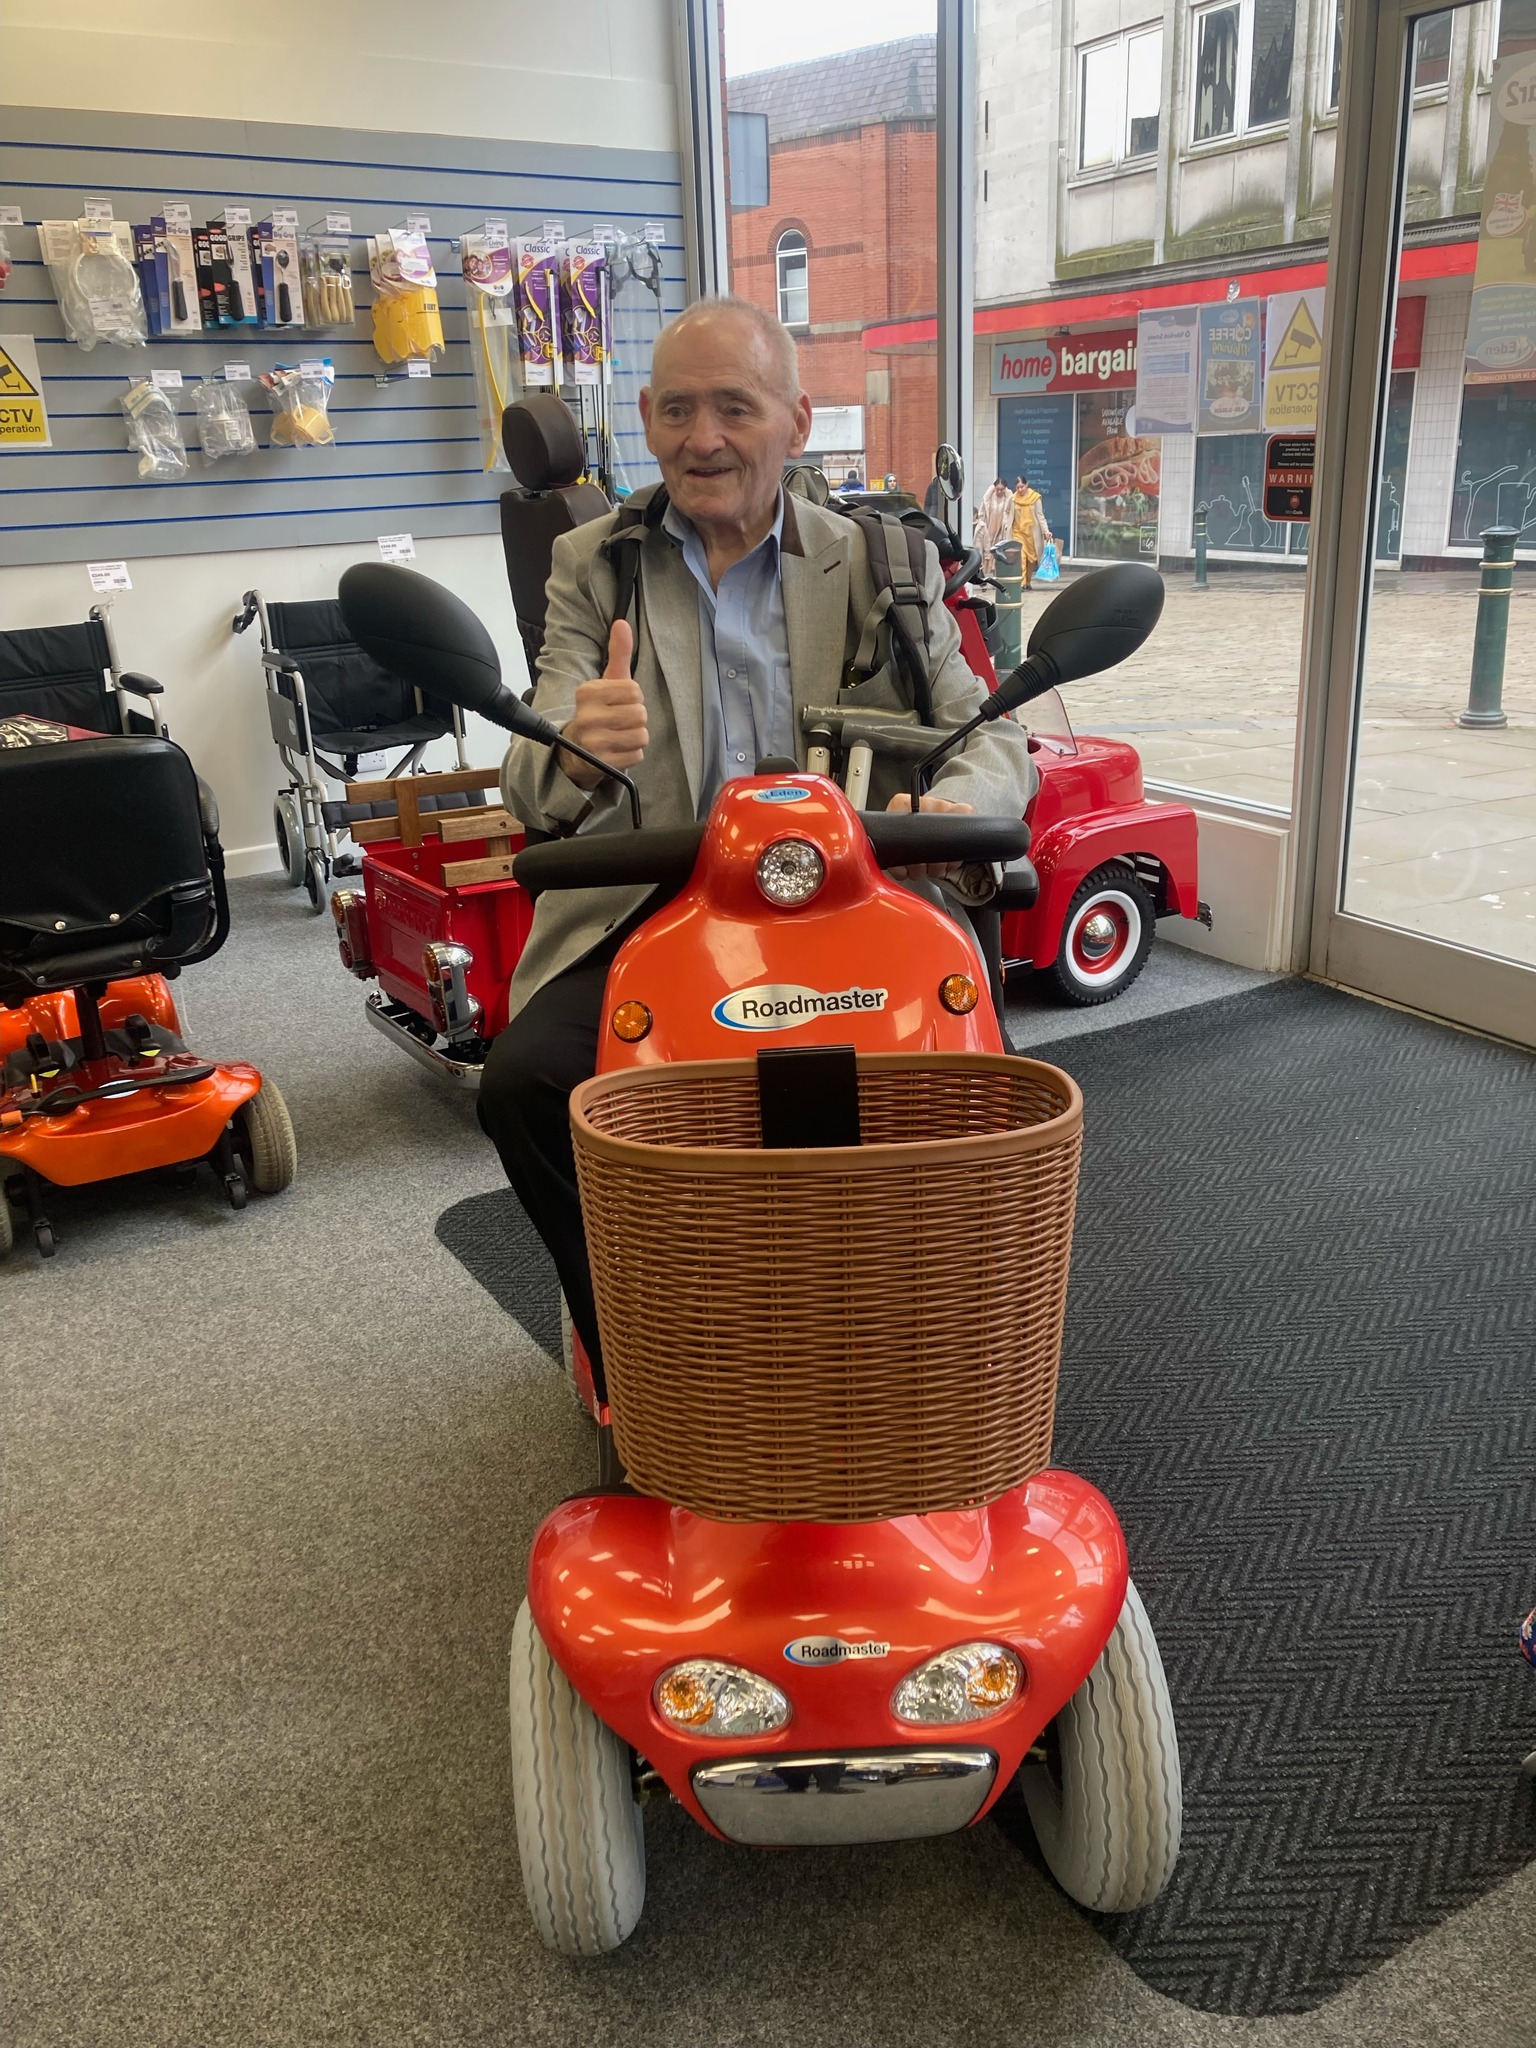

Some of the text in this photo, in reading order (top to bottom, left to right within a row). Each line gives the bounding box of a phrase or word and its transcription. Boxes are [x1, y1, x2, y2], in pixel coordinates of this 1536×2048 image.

[167, 226, 189, 235] Big-Grip
[273, 231, 294, 239] Big-Grip
[210, 234, 227, 242] GOOD
[524, 243, 550, 253] Classic
[575, 245, 600, 256] Classic
[1000, 353, 1052, 380] home
[1061, 340, 1136, 380] bargai
[0, 408, 33, 423] CTV
[0, 424, 41, 435] peration
[770, 787, 803, 797] Eden
[742, 991, 884, 1019] Roadmaster
[801, 1643, 888, 1658] Roadmaster
